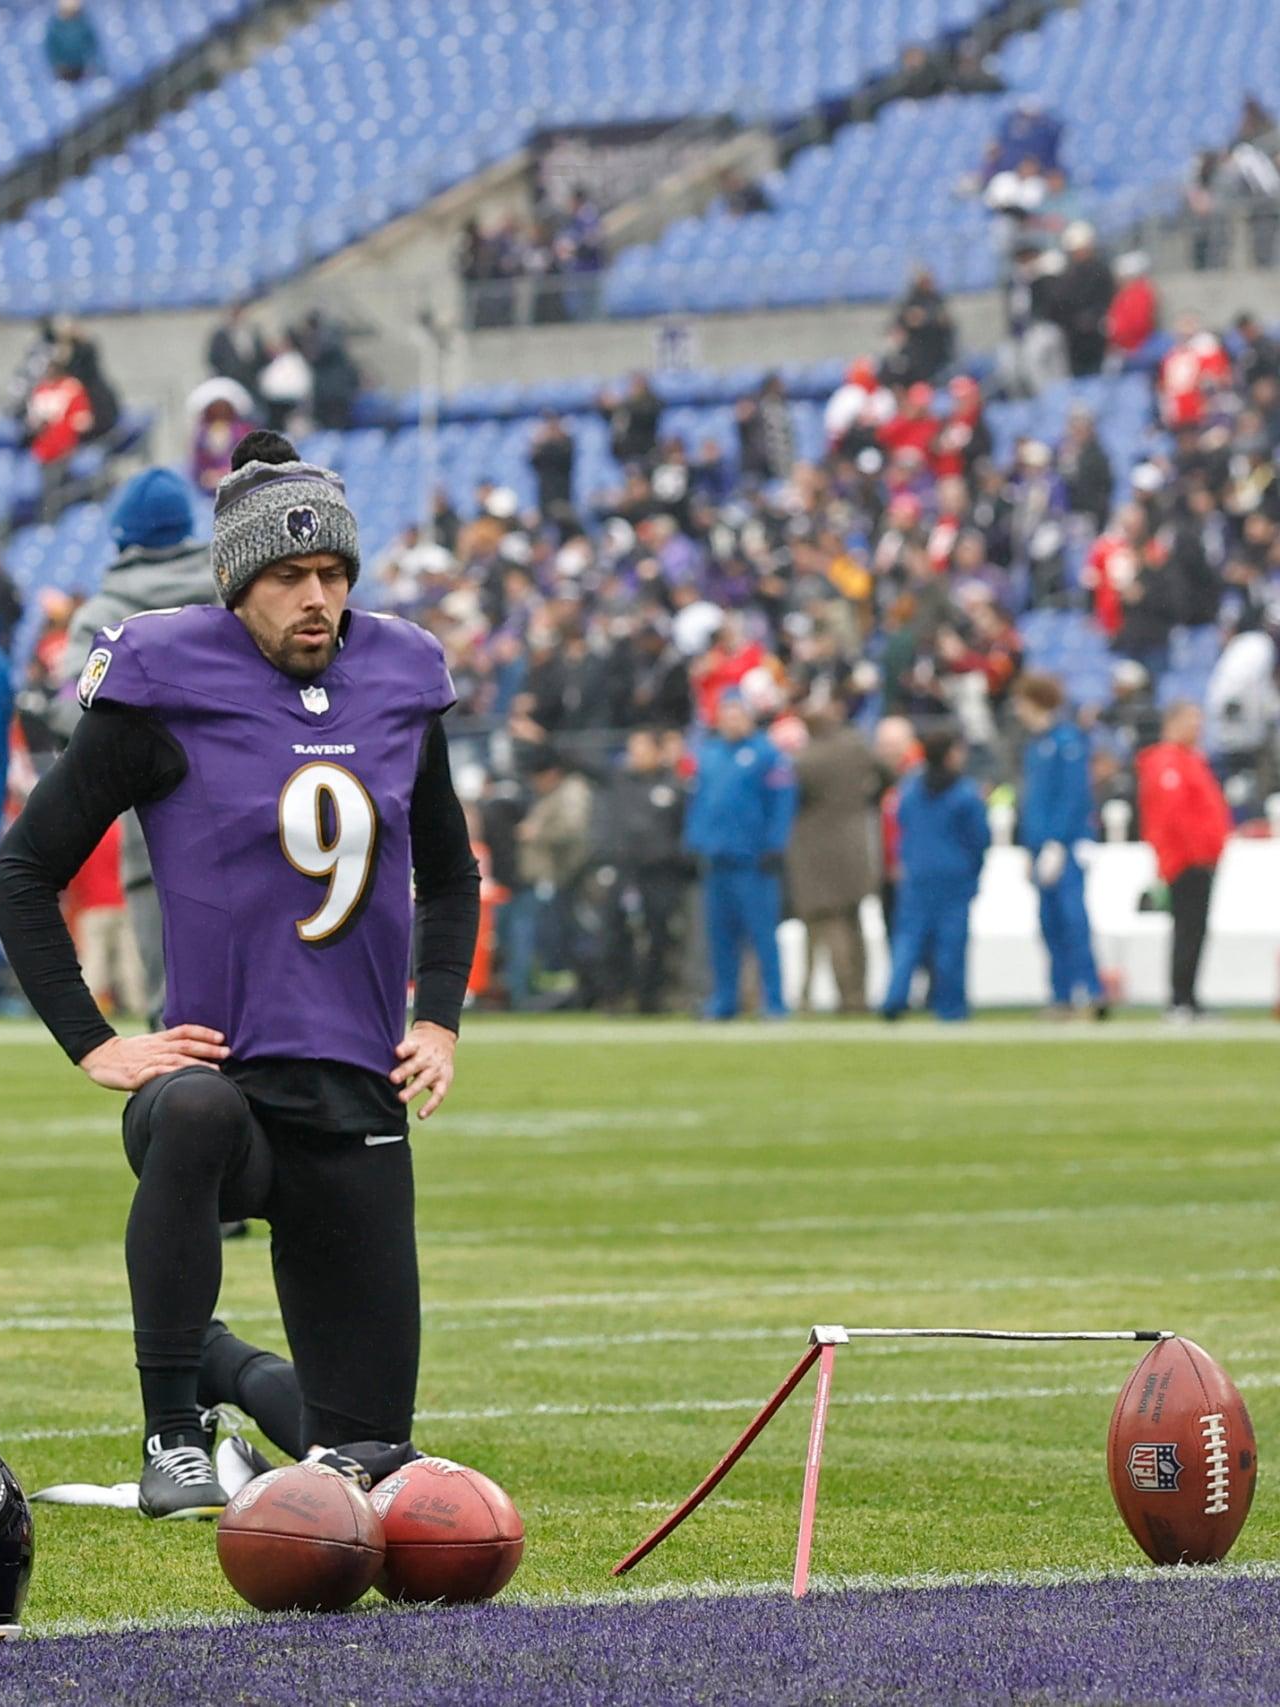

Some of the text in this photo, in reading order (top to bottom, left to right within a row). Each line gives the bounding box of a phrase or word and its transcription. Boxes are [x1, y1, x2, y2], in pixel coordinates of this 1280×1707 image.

[292, 744, 356, 756] RAVENS
[278, 760, 377, 943] 9
[1133, 1449, 1157, 1487] NFL
